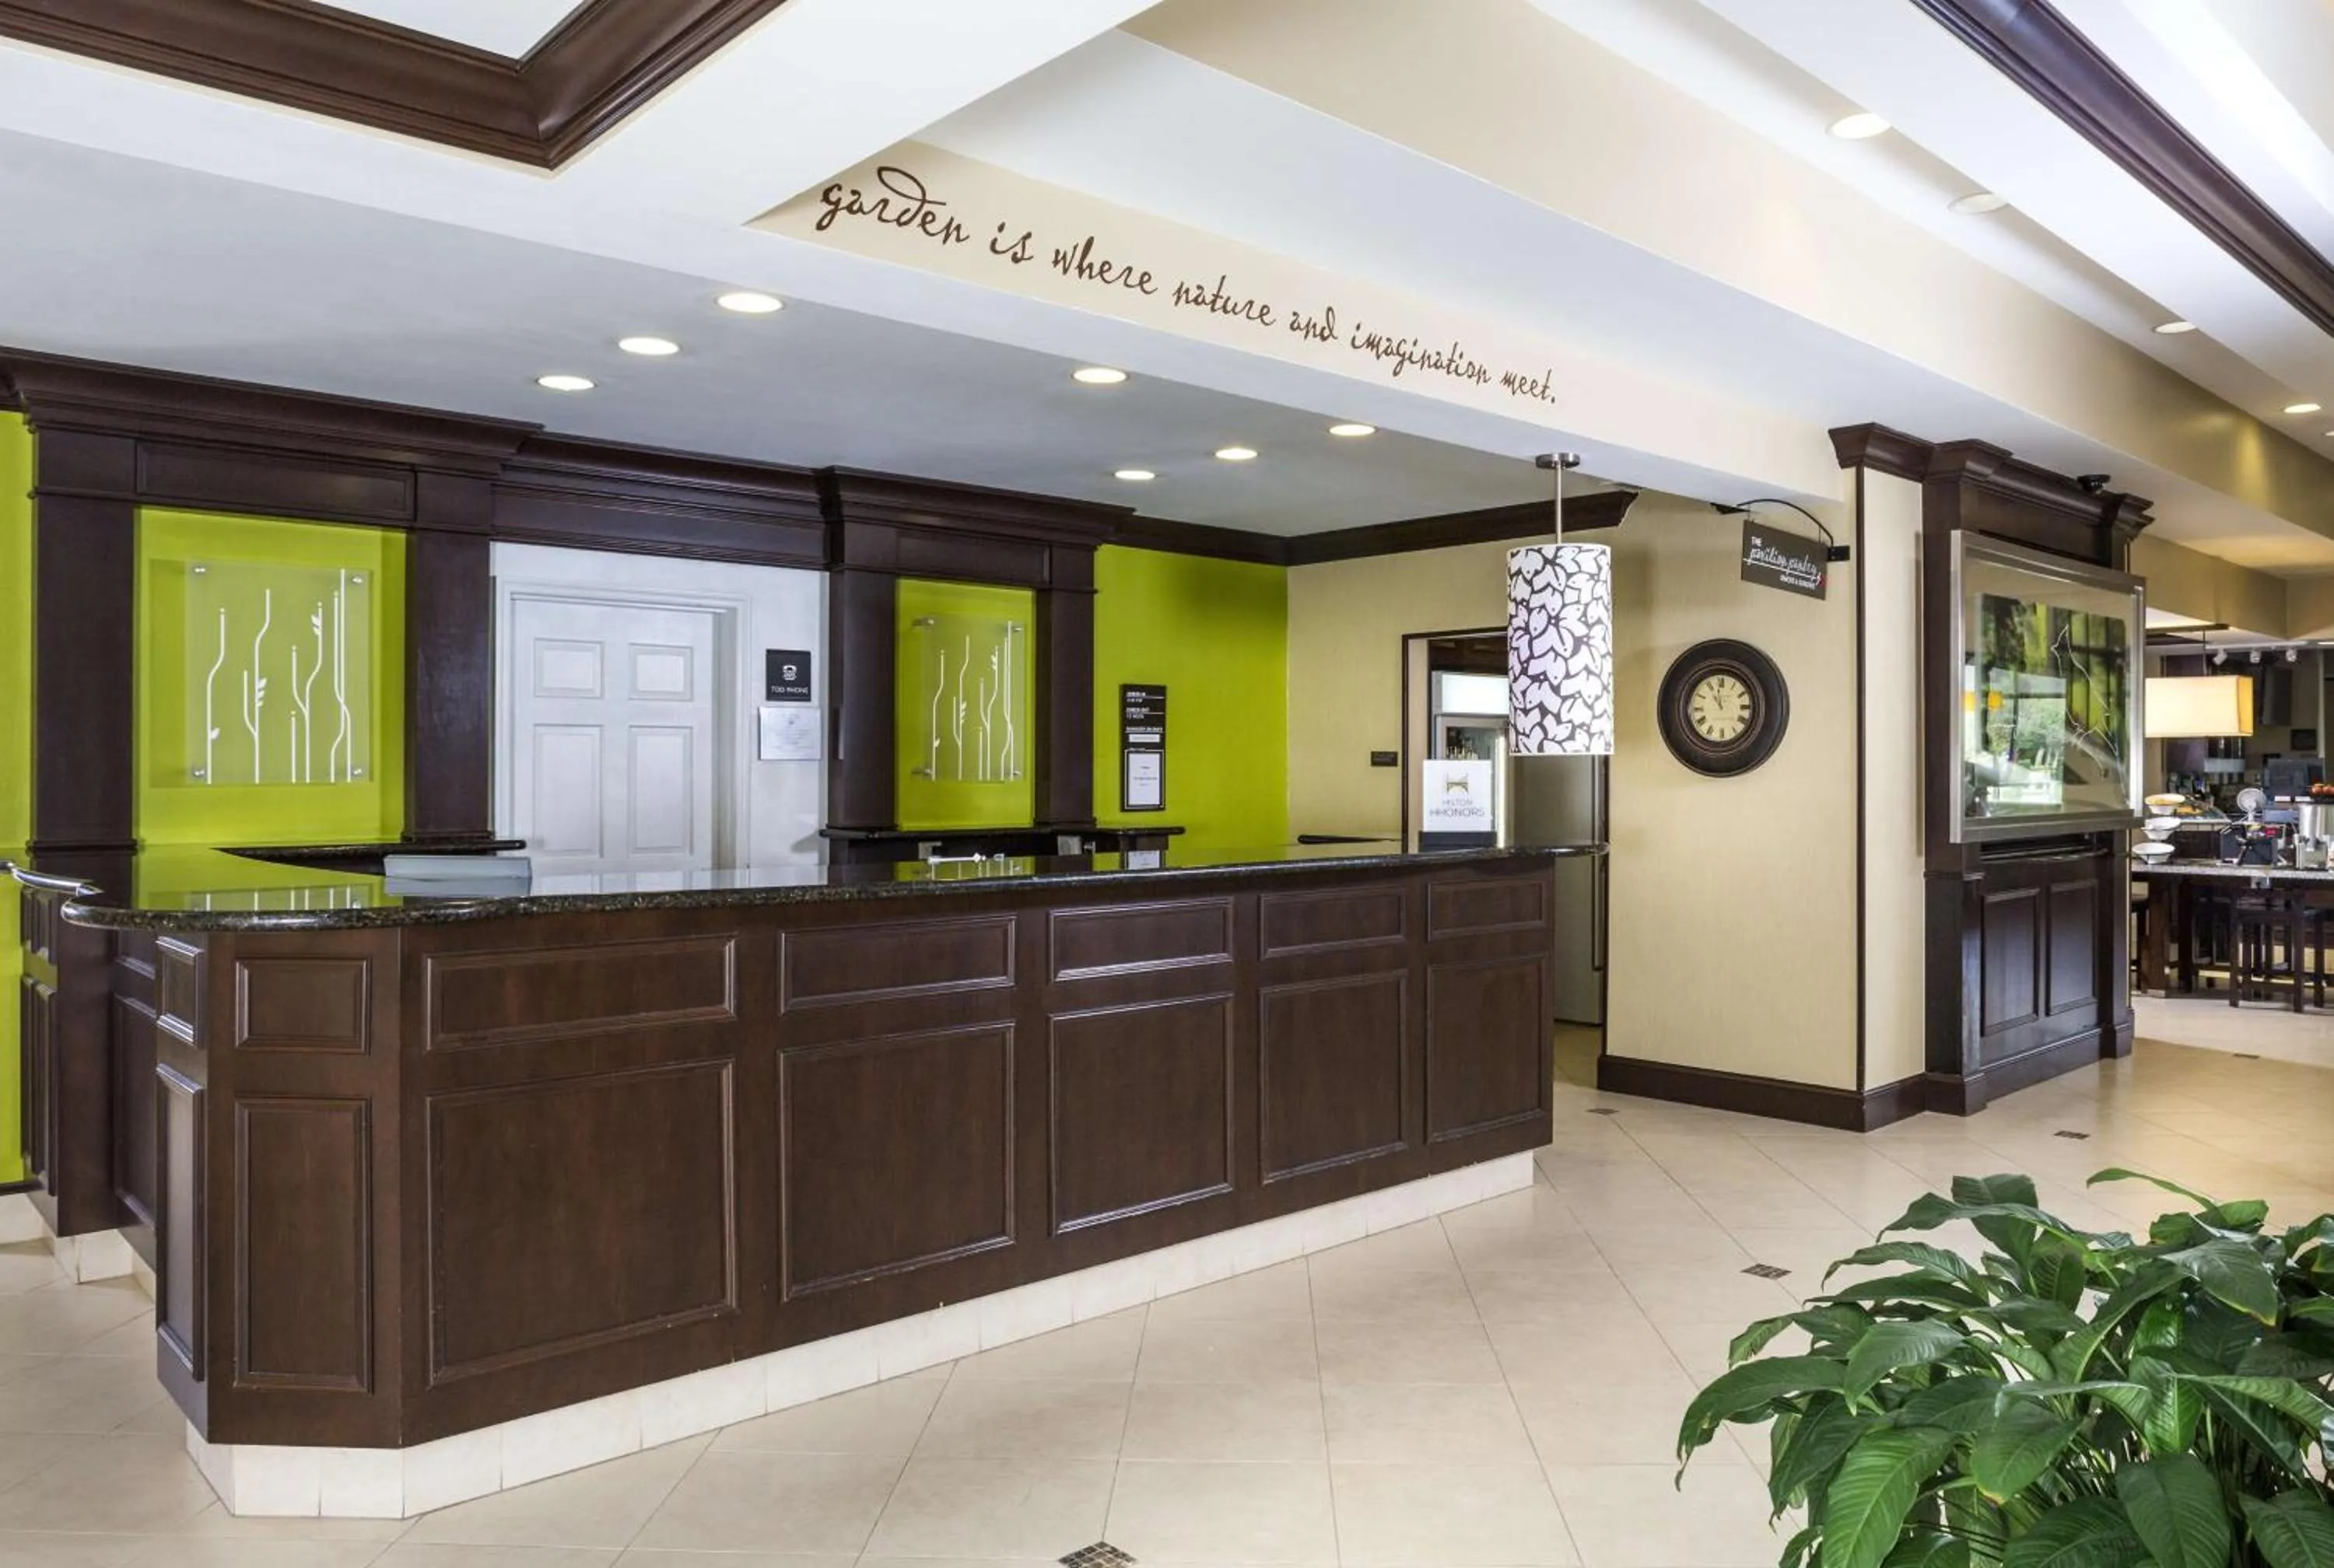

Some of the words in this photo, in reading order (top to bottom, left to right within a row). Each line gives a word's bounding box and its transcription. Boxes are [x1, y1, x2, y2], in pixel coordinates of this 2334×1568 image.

[815, 166, 970, 245] garden
[990, 222, 1034, 264] is
[1052, 236, 1158, 295] where
[1172, 275, 1277, 326] nature
[1290, 306, 1339, 342] and
[1351, 324, 1491, 385] imagination
[1500, 368, 1555, 404] meet.
